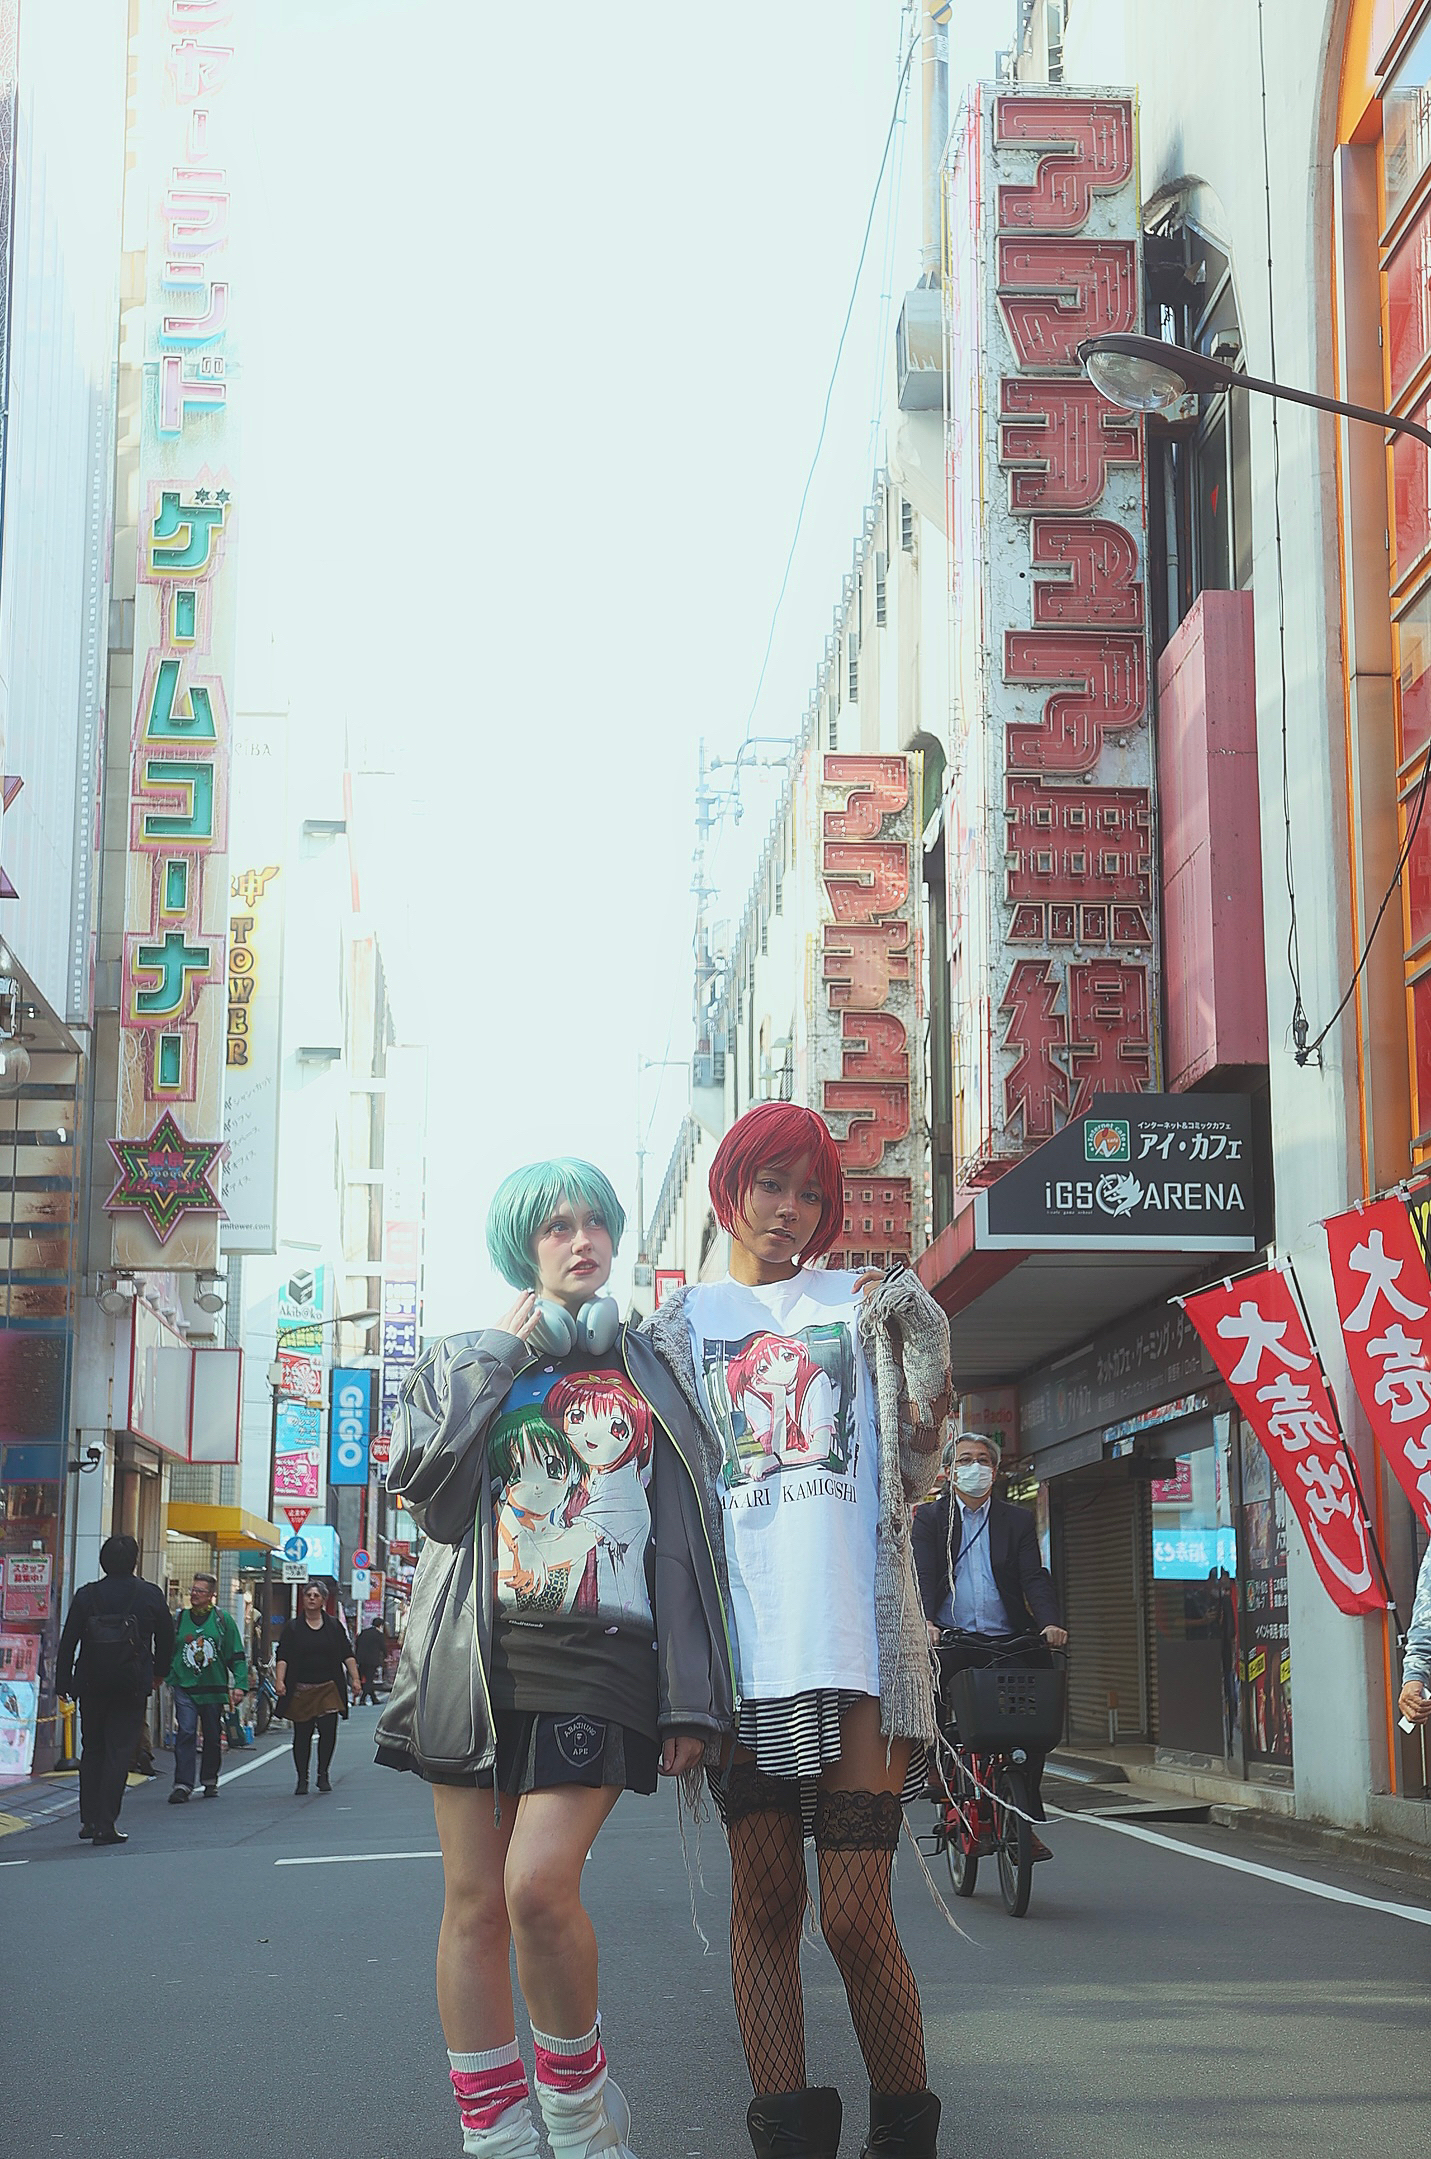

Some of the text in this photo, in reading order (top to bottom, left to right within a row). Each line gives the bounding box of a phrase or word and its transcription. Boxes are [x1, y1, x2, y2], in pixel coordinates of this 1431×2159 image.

[135, 487, 231, 1088] ゲームコーナー
[226, 917, 255, 1066] TOWER
[1137, 1132, 1243, 1161] アイ・カフェ
[1045, 1182, 1246, 1211] iGS ARENA
[1097, 1313, 1199, 1385] ネットカフェ・ゲーミング・ダー
[337, 1385, 365, 1468] GiGO
[572, 1747, 589, 1756] APE
